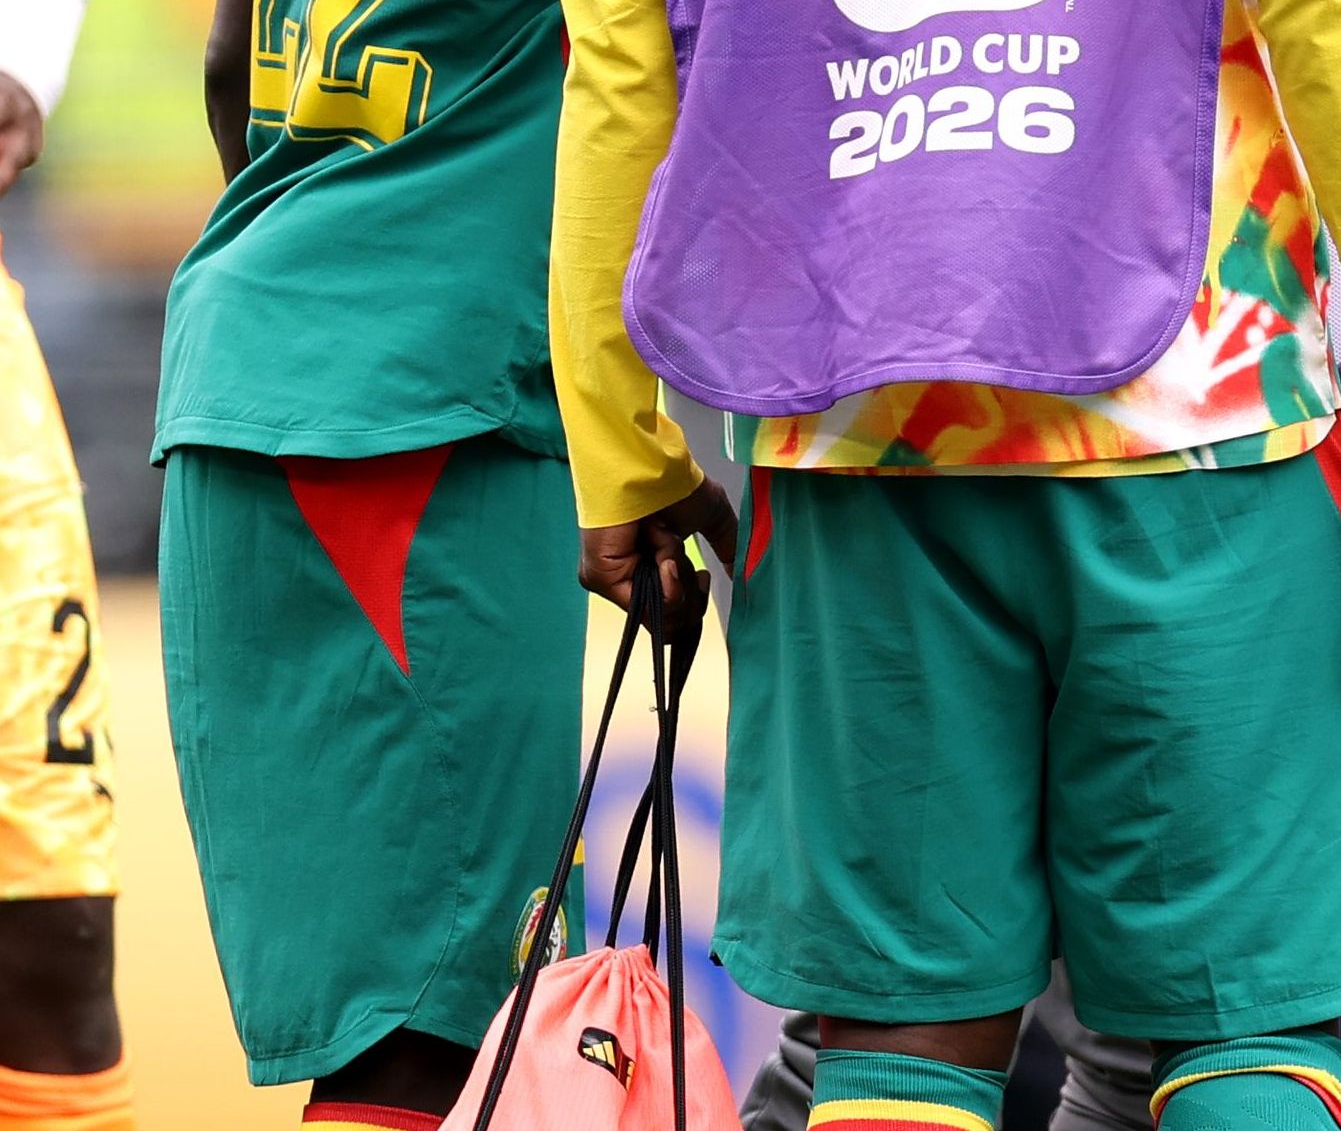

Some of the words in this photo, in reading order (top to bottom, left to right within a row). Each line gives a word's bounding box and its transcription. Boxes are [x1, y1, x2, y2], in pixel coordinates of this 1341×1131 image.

[826, 37, 963, 102] WORLD
[973, 33, 1080, 77] CUP
[829, 85, 1076, 180] 2026
[45, 598, 95, 764] 2
